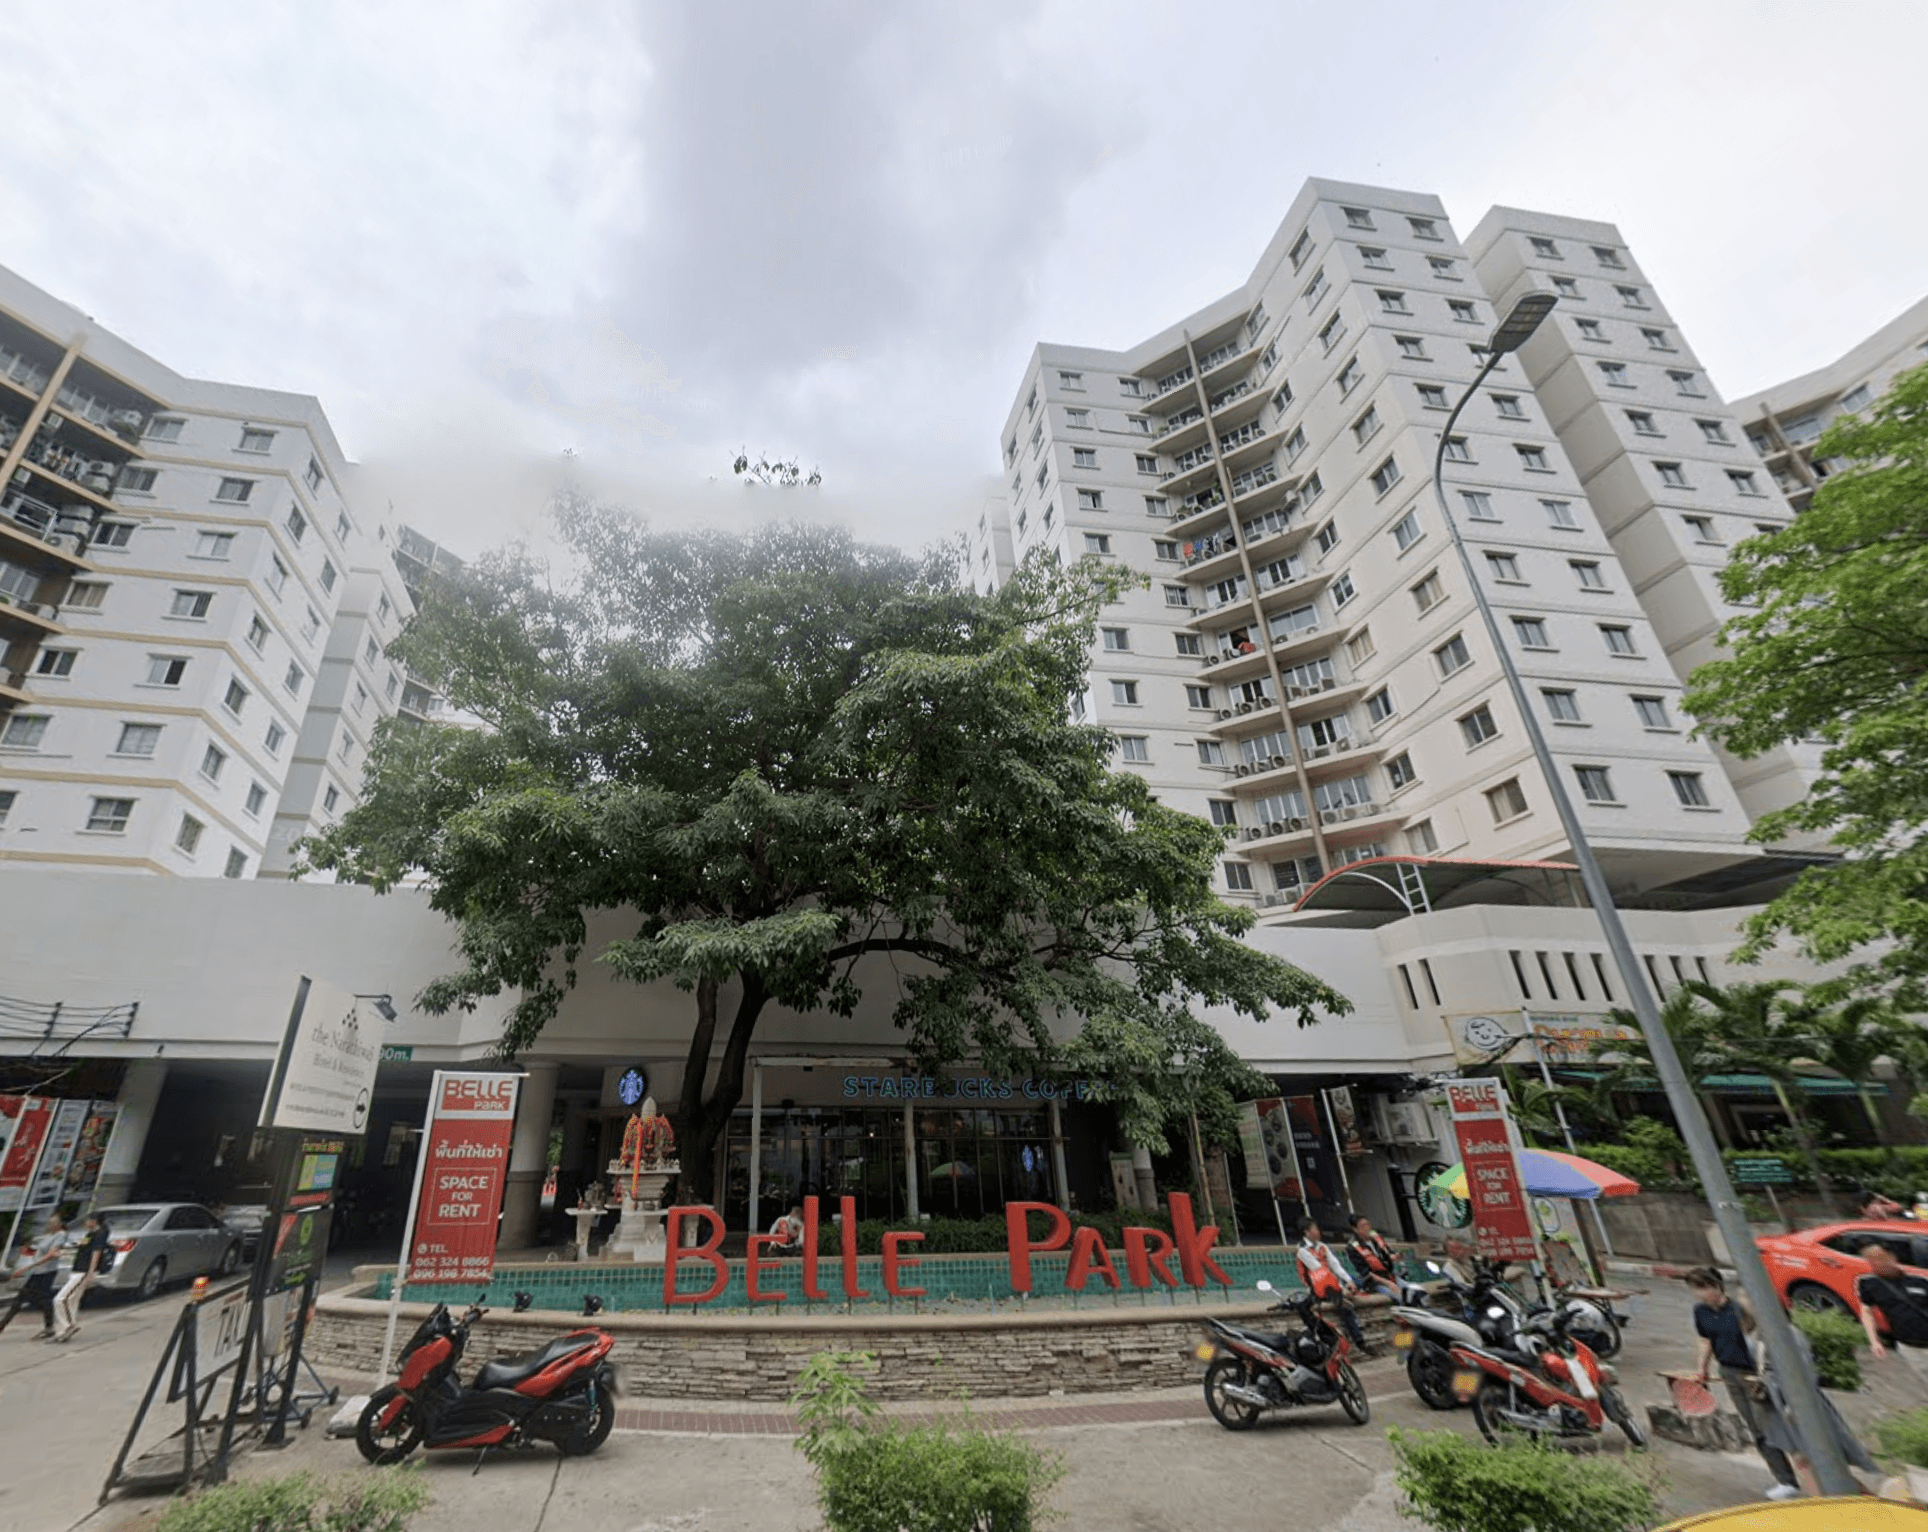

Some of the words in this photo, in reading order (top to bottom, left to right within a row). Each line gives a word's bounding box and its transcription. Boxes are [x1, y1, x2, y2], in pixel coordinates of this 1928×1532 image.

[445, 1079, 513, 1097] BELLE
[440, 1175, 489, 1190] SPACE
[451, 1191, 473, 1201] FOR
[438, 1203, 481, 1218] RENT
